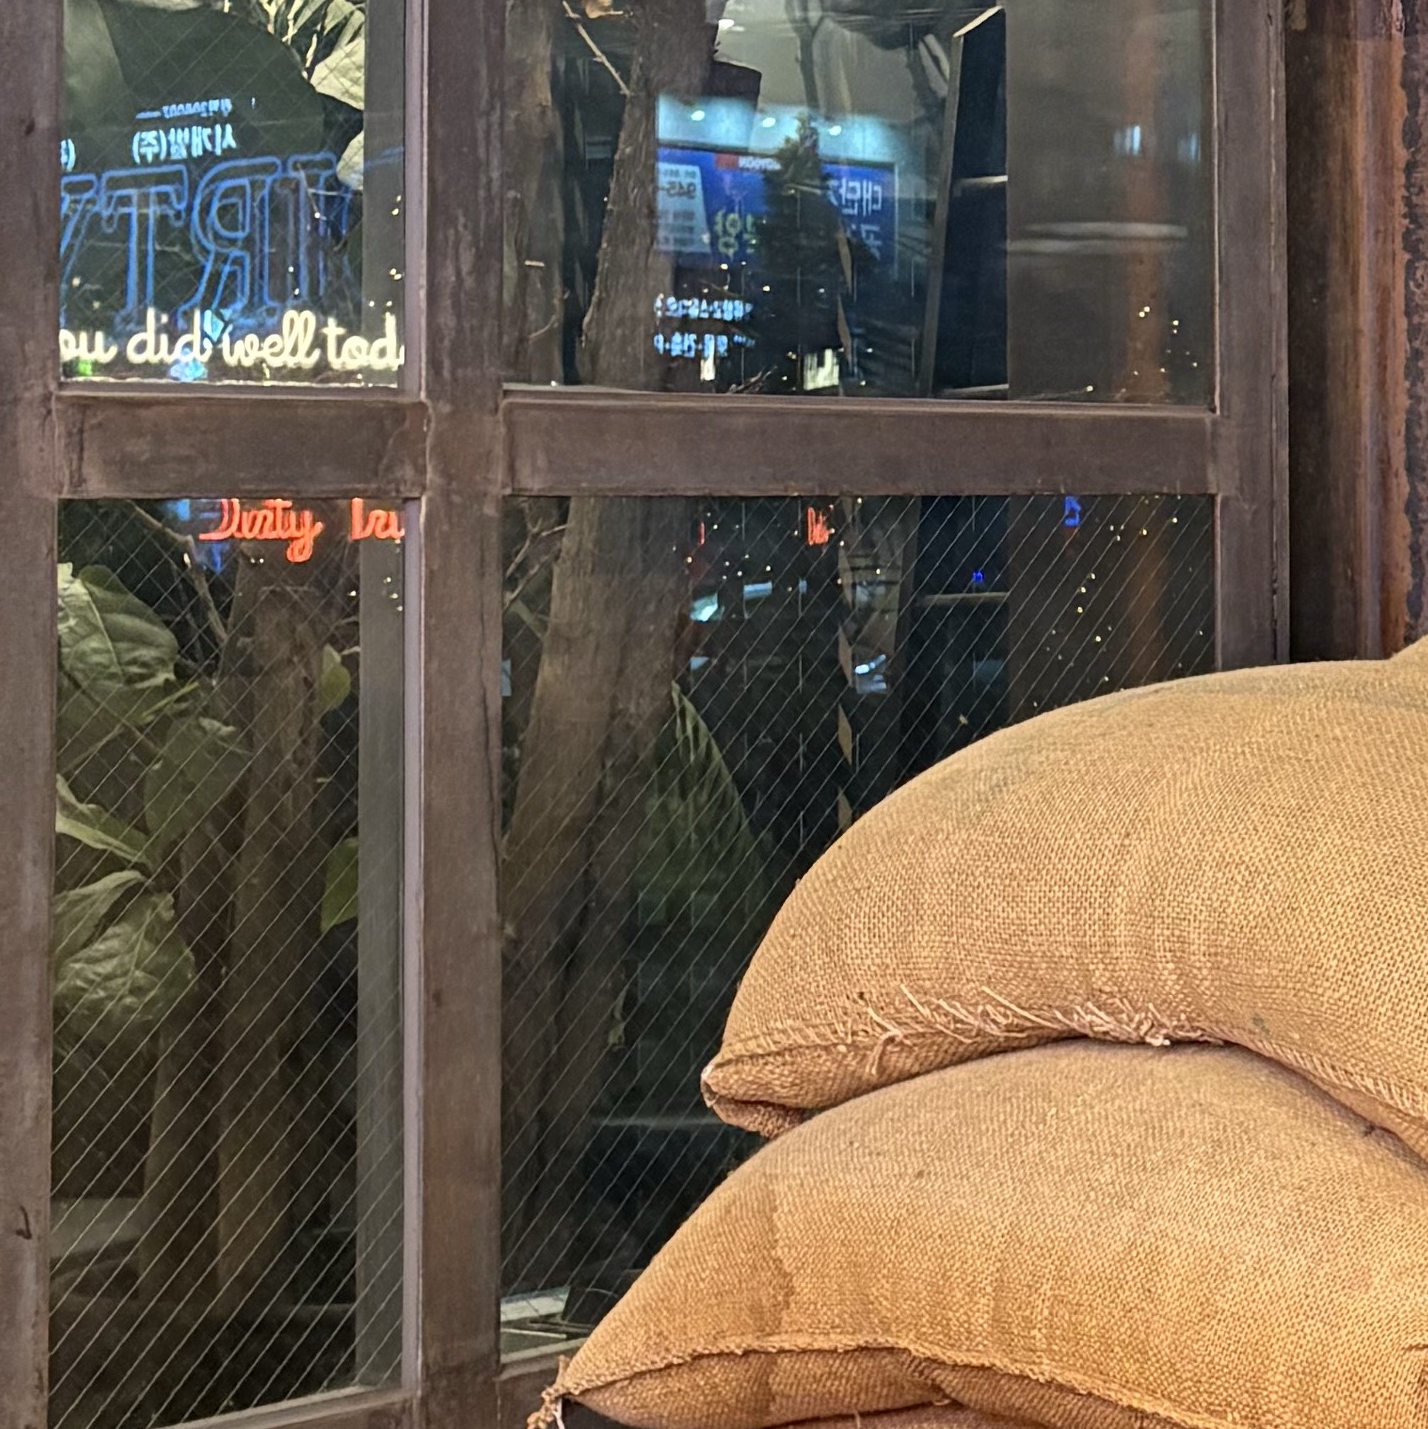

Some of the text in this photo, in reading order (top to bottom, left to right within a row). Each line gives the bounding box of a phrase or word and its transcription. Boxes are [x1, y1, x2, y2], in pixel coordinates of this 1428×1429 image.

[127, 307, 213, 365] did
[221, 310, 322, 369] well
[322, 311, 405, 371] tod
